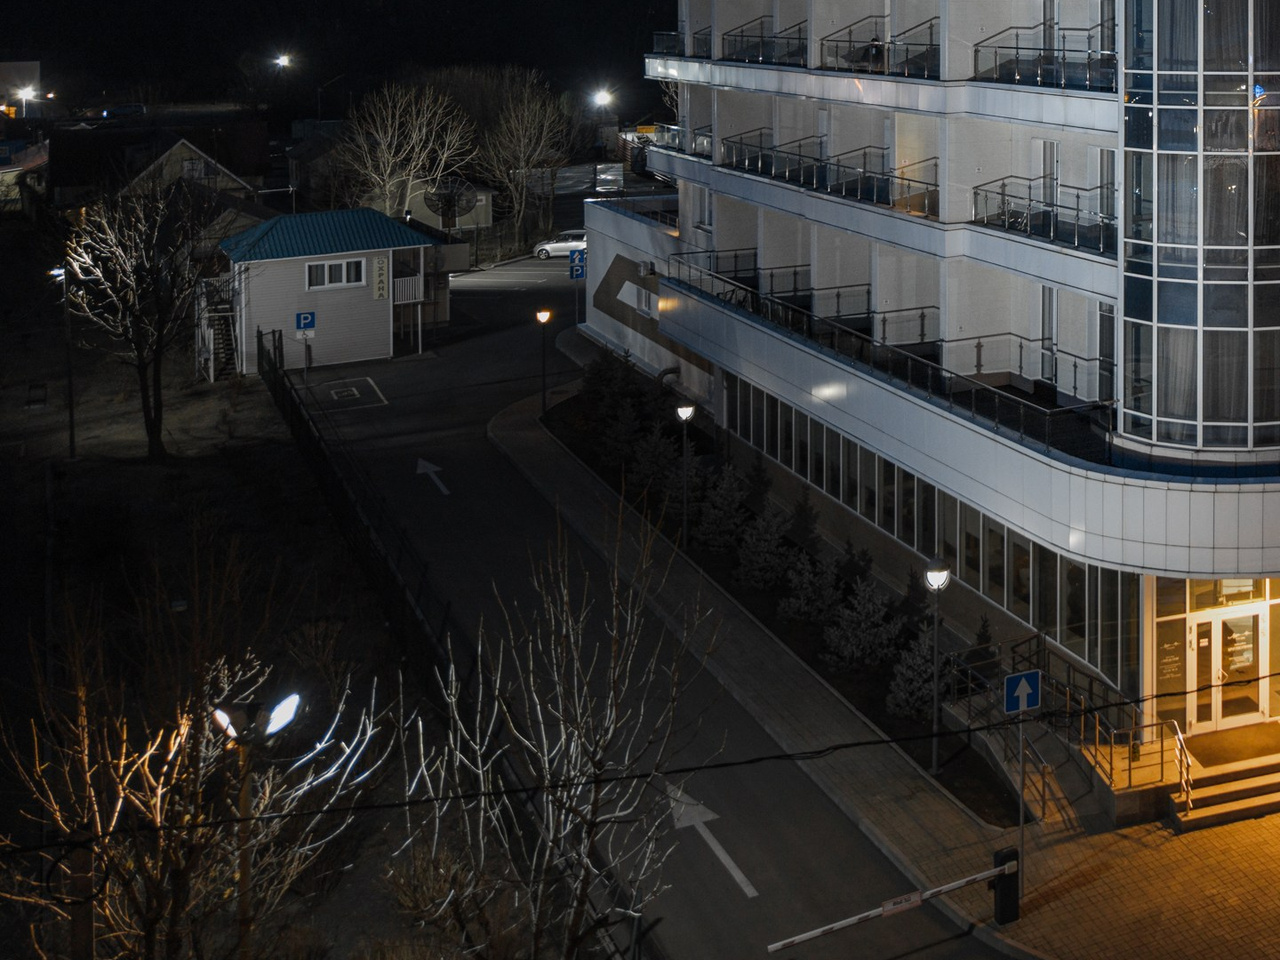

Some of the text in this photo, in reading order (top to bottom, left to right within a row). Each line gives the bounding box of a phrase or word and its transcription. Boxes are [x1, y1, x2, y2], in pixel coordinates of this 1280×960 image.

[377, 259, 385, 299] ОХРАНА
[573, 266, 582, 278] P
[300, 313, 312, 328] P
